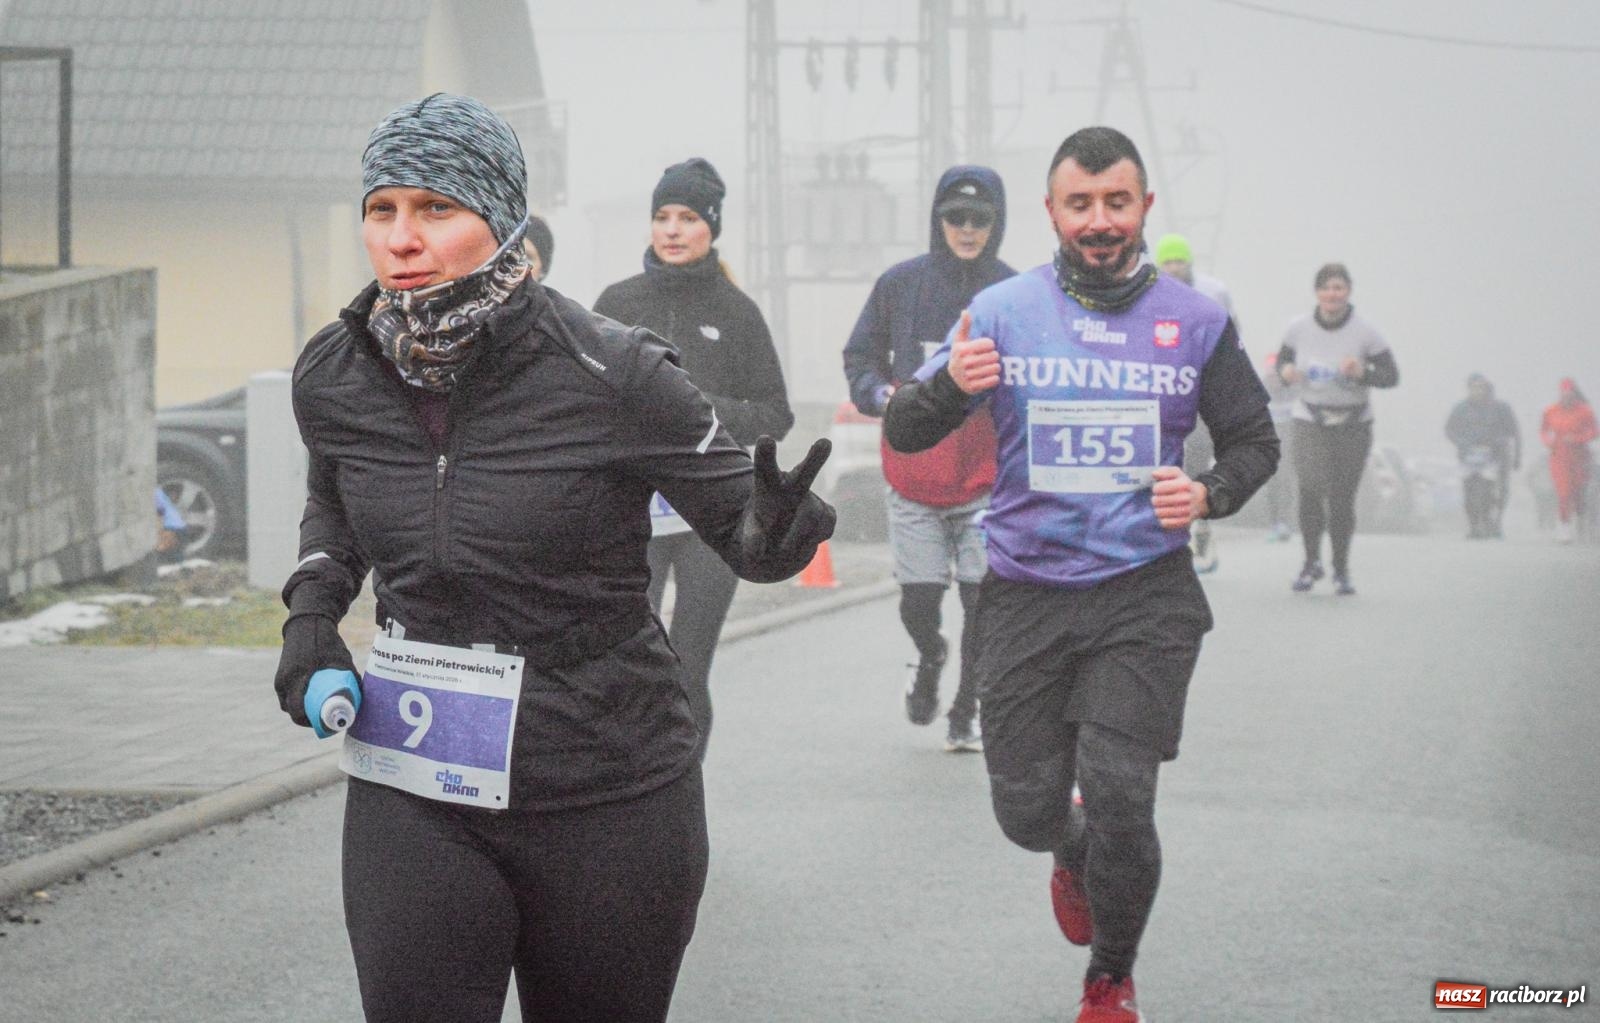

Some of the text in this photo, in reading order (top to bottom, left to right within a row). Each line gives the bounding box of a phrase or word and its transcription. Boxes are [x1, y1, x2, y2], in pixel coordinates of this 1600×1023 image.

[1002, 355, 1198, 396] RUNNERS
[1053, 427, 1135, 465] 155
[392, 653, 404, 663] po
[405, 654, 435, 667] Ziemi
[435, 658, 505, 679] Pietrowickiej
[398, 690, 433, 749] 9
